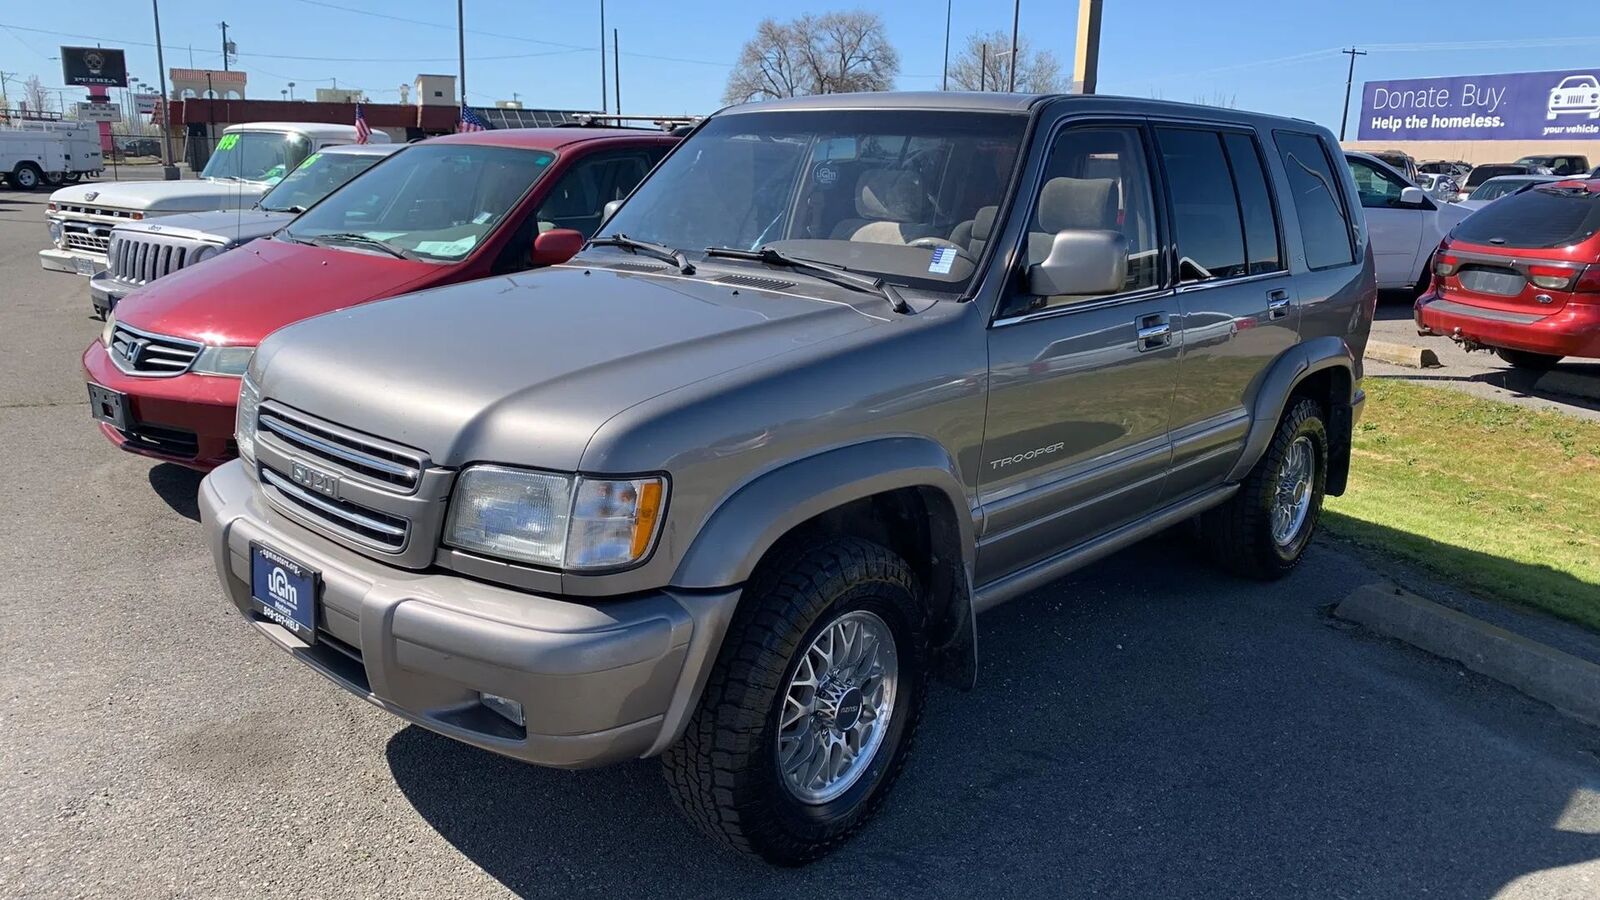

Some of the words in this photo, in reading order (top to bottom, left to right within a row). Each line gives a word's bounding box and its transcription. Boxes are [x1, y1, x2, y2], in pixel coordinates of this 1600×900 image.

[1373, 87, 1453, 110] Donate.
[1462, 83, 1506, 113] Buy.
[1371, 115, 1402, 132] Help
[1405, 114, 1428, 128] the
[1431, 113, 1505, 128] homeless.
[1542, 126, 1565, 136] your
[1566, 124, 1599, 133] vehicle
[990, 441, 1064, 469] TROOPER
[291, 461, 339, 498] ISUZU
[275, 601, 292, 616] Motors
